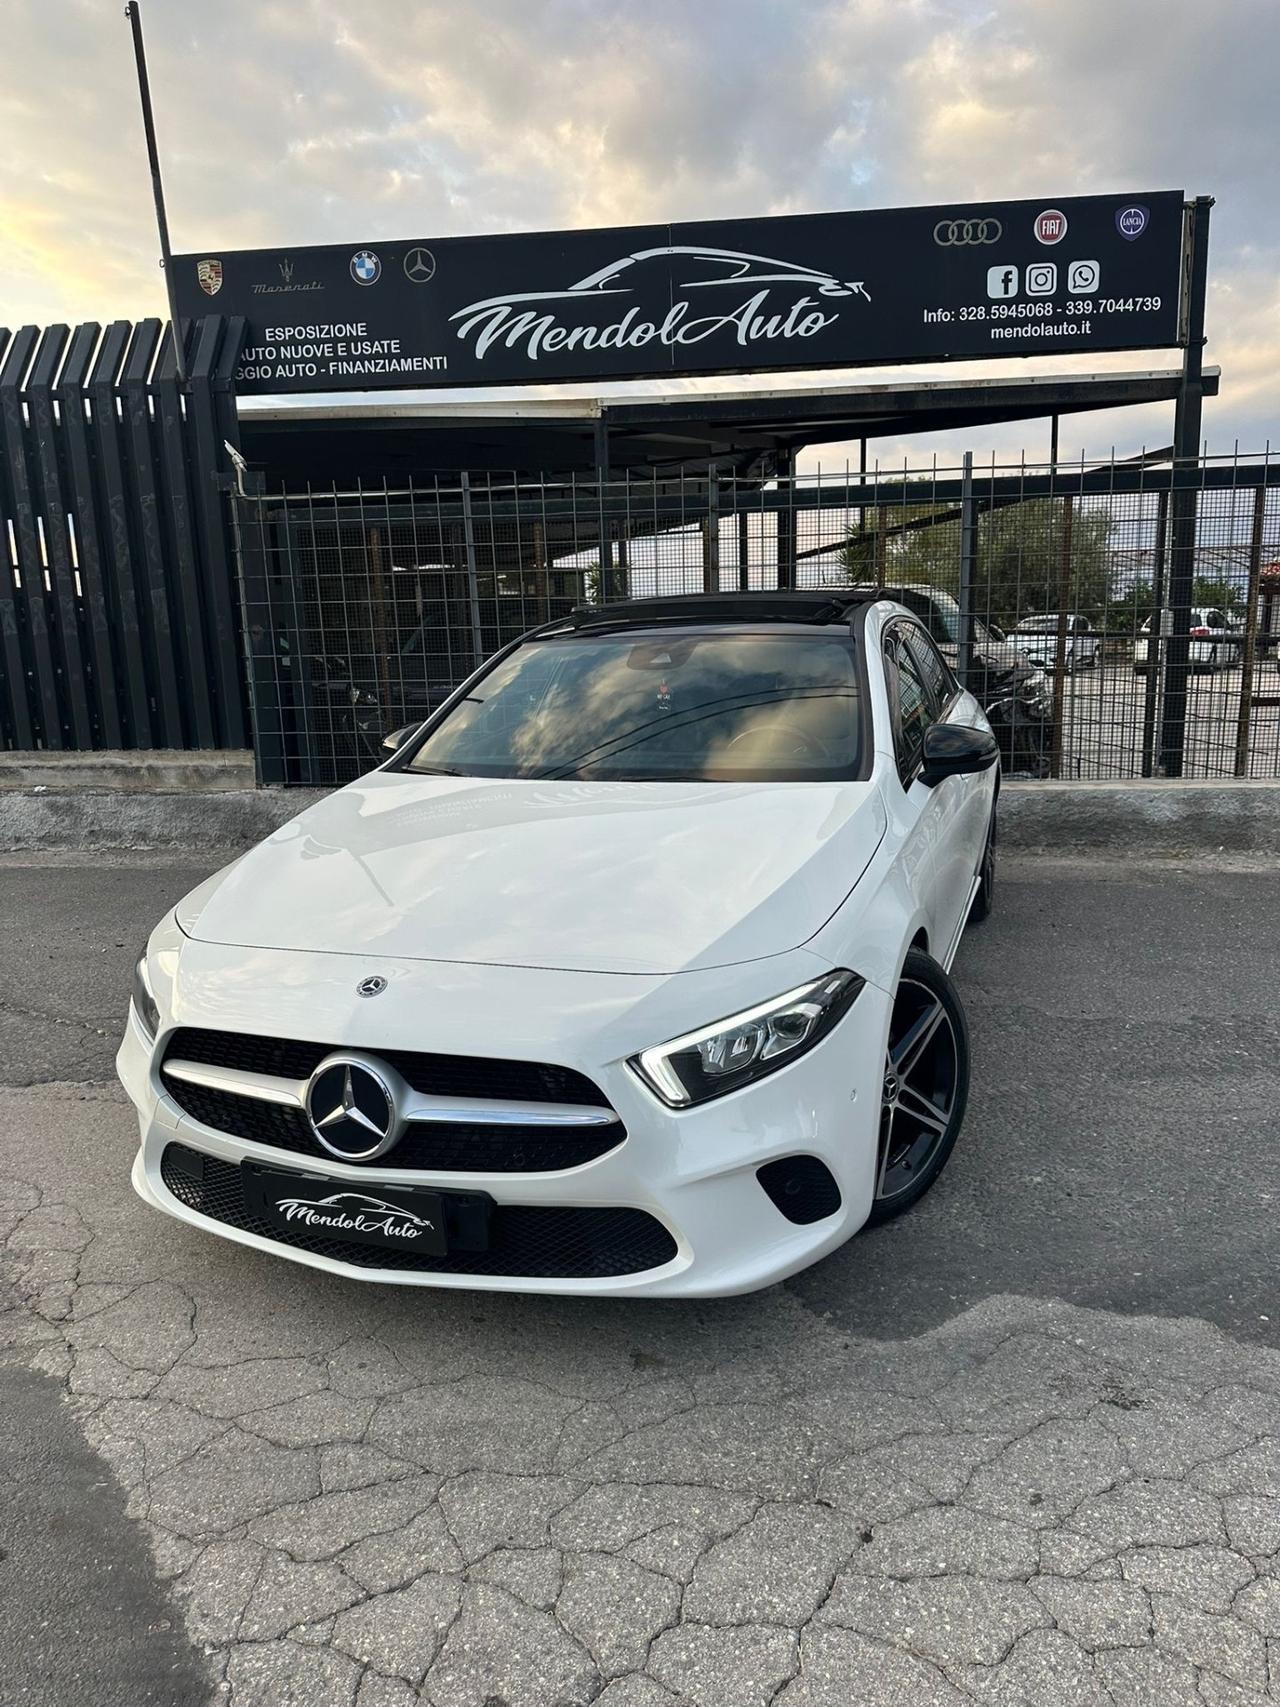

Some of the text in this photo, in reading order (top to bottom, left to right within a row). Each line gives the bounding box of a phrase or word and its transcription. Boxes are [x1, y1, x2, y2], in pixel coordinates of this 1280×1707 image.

[1042, 220, 1061, 235] FIAT
[923, 308, 955, 323] Info:
[959, 303, 1053, 321] 328.5945068
[1065, 296, 1162, 315] 339.7044739
[265, 322, 367, 341] ESPOSIZIONE
[457, 289, 839, 360] MendolAuto
[991, 320, 1092, 339] mendolauto.it
[280, 343, 334, 359] NUOVE
[337, 343, 347, 356] E
[351, 339, 401, 355] USATE
[235, 366, 272, 380] GGIO
[275, 362, 317, 378] AUTO
[329, 356, 448, 375] FINANZIAMENTI
[279, 1202, 422, 1239] MendolAuto
